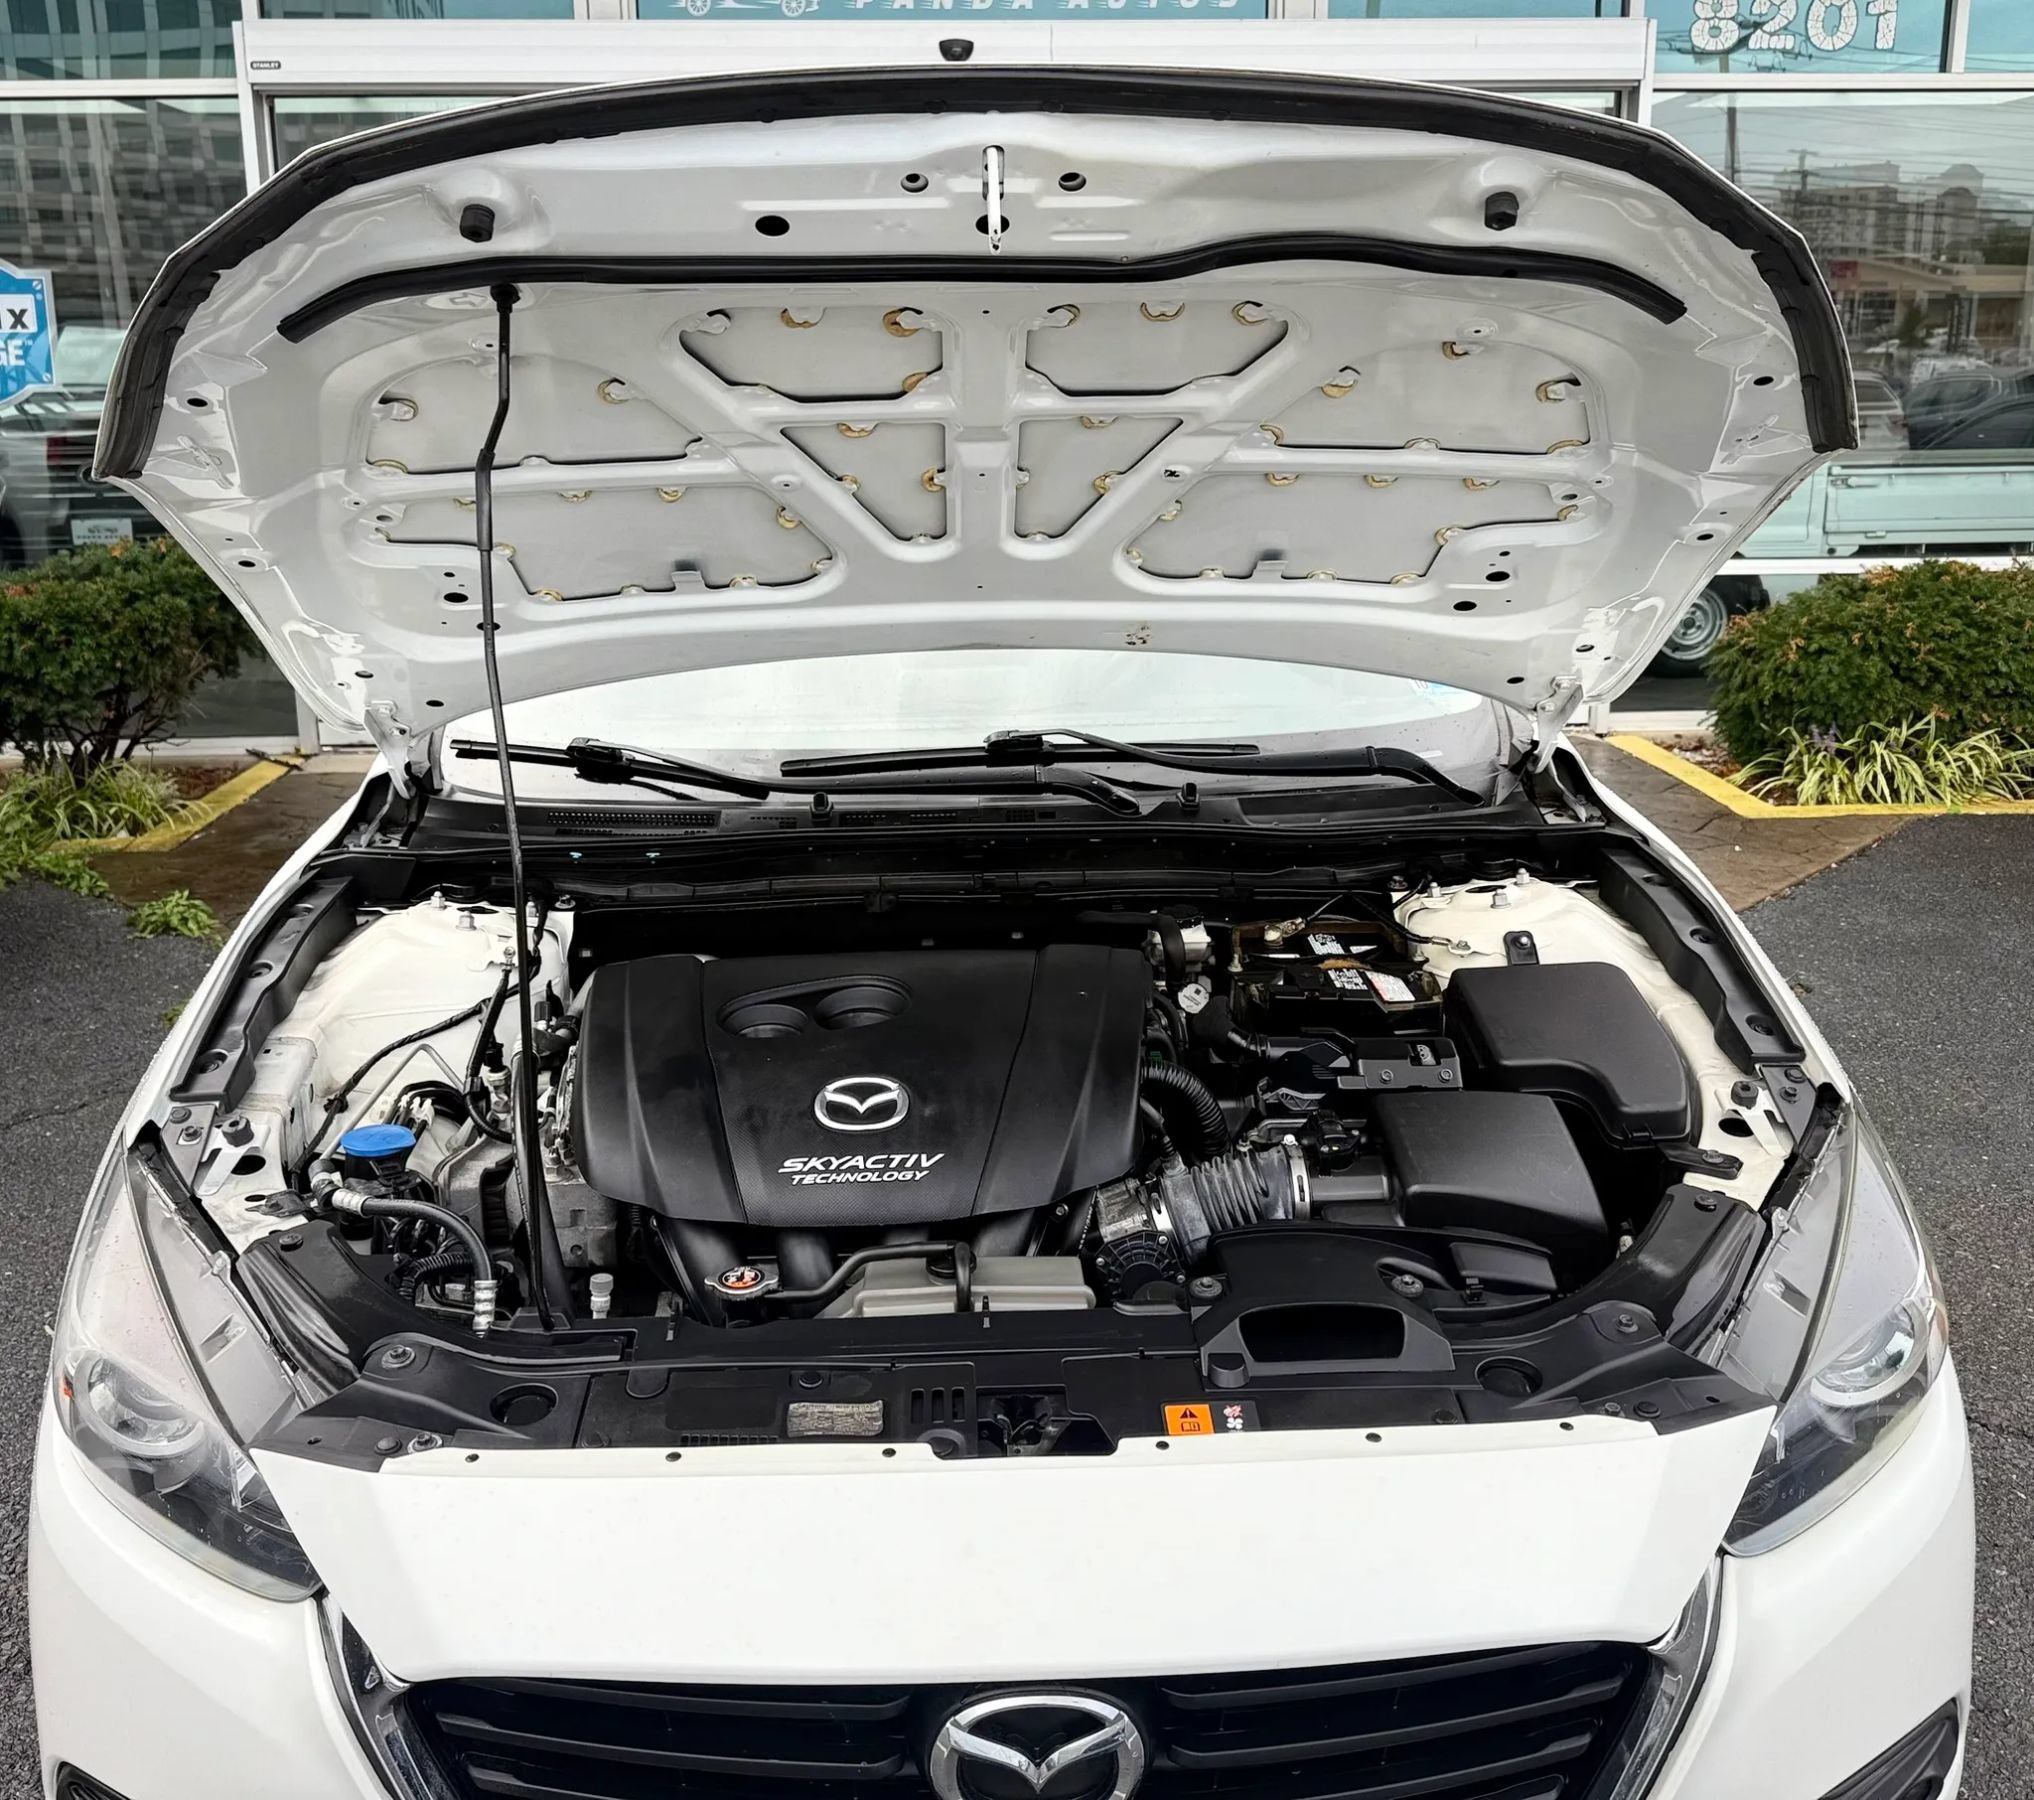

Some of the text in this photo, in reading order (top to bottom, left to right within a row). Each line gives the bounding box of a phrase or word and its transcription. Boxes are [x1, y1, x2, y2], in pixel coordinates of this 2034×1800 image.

[1690, 0, 1898, 51] 8201
[0, 309, 29, 330] X
[777, 1153, 945, 1173] SKYACTIV
[791, 1170, 930, 1186] TECHNOLOGY
